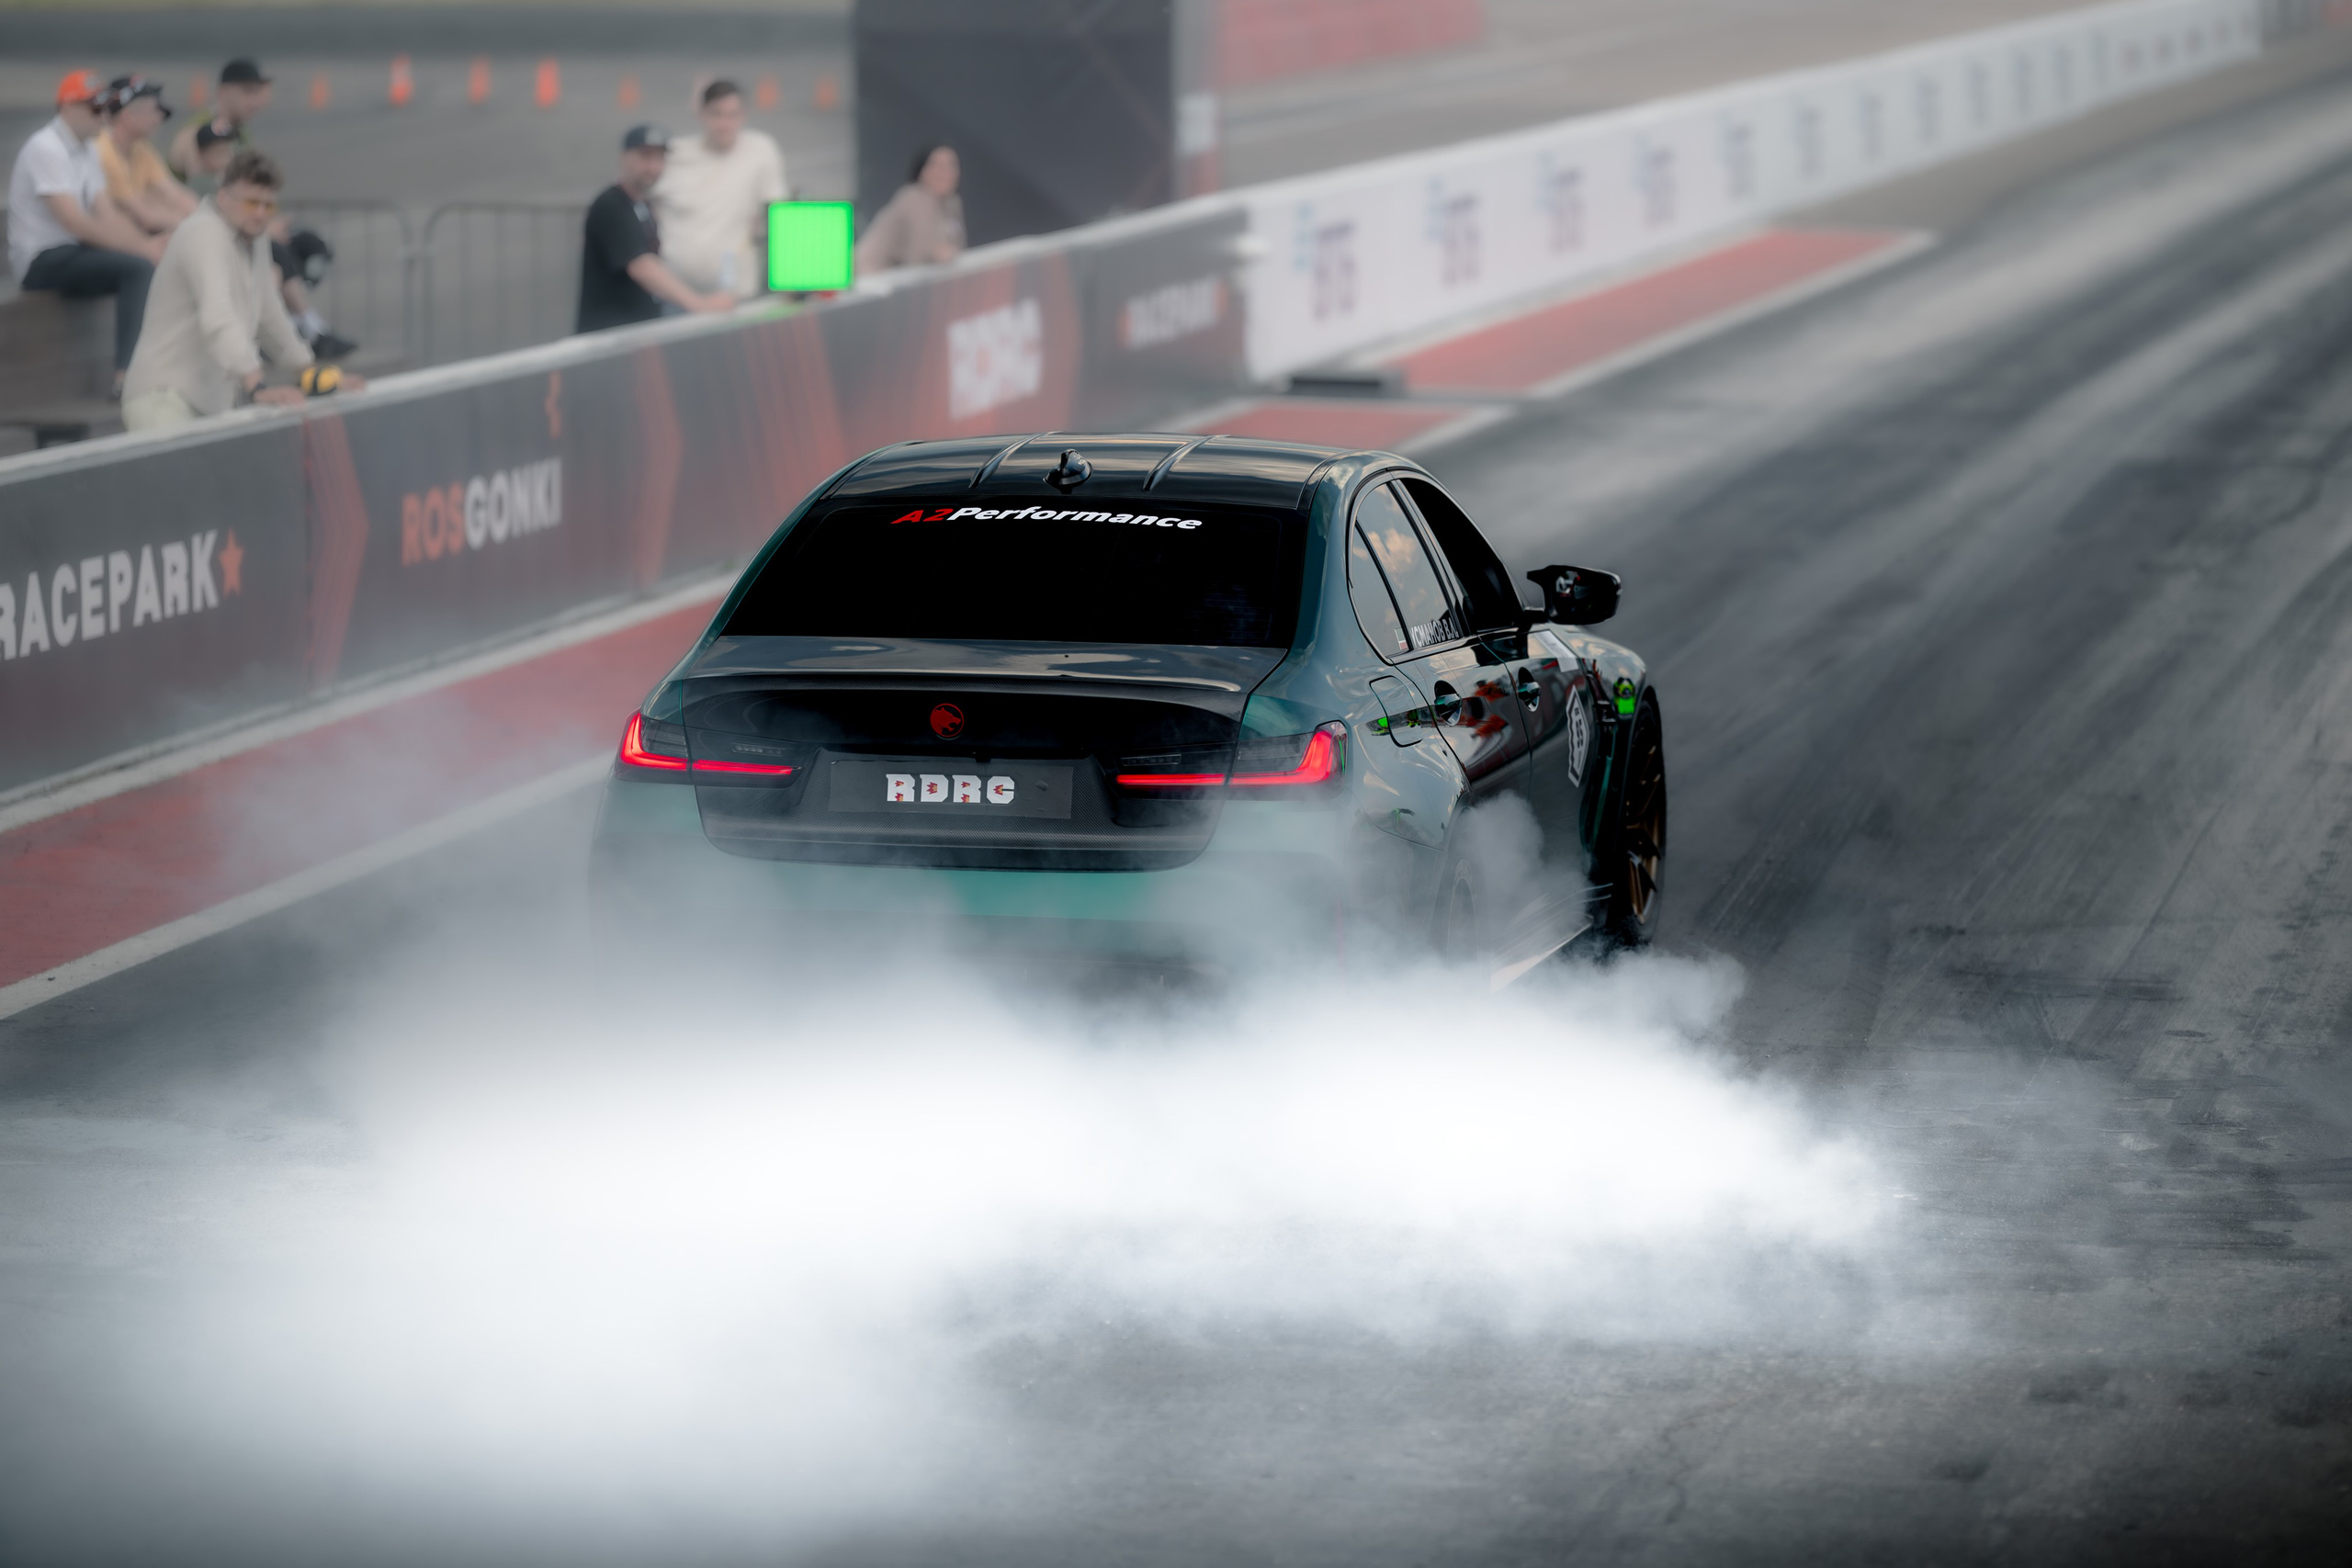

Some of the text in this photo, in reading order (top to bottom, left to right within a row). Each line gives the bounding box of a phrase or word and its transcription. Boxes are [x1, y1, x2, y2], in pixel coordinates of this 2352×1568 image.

[401, 456, 563, 567] ROSGONKI
[890, 505, 1203, 530] A2Performance
[0, 529, 219, 660] RACEPARK
[886, 773, 1015, 804] RDRG
